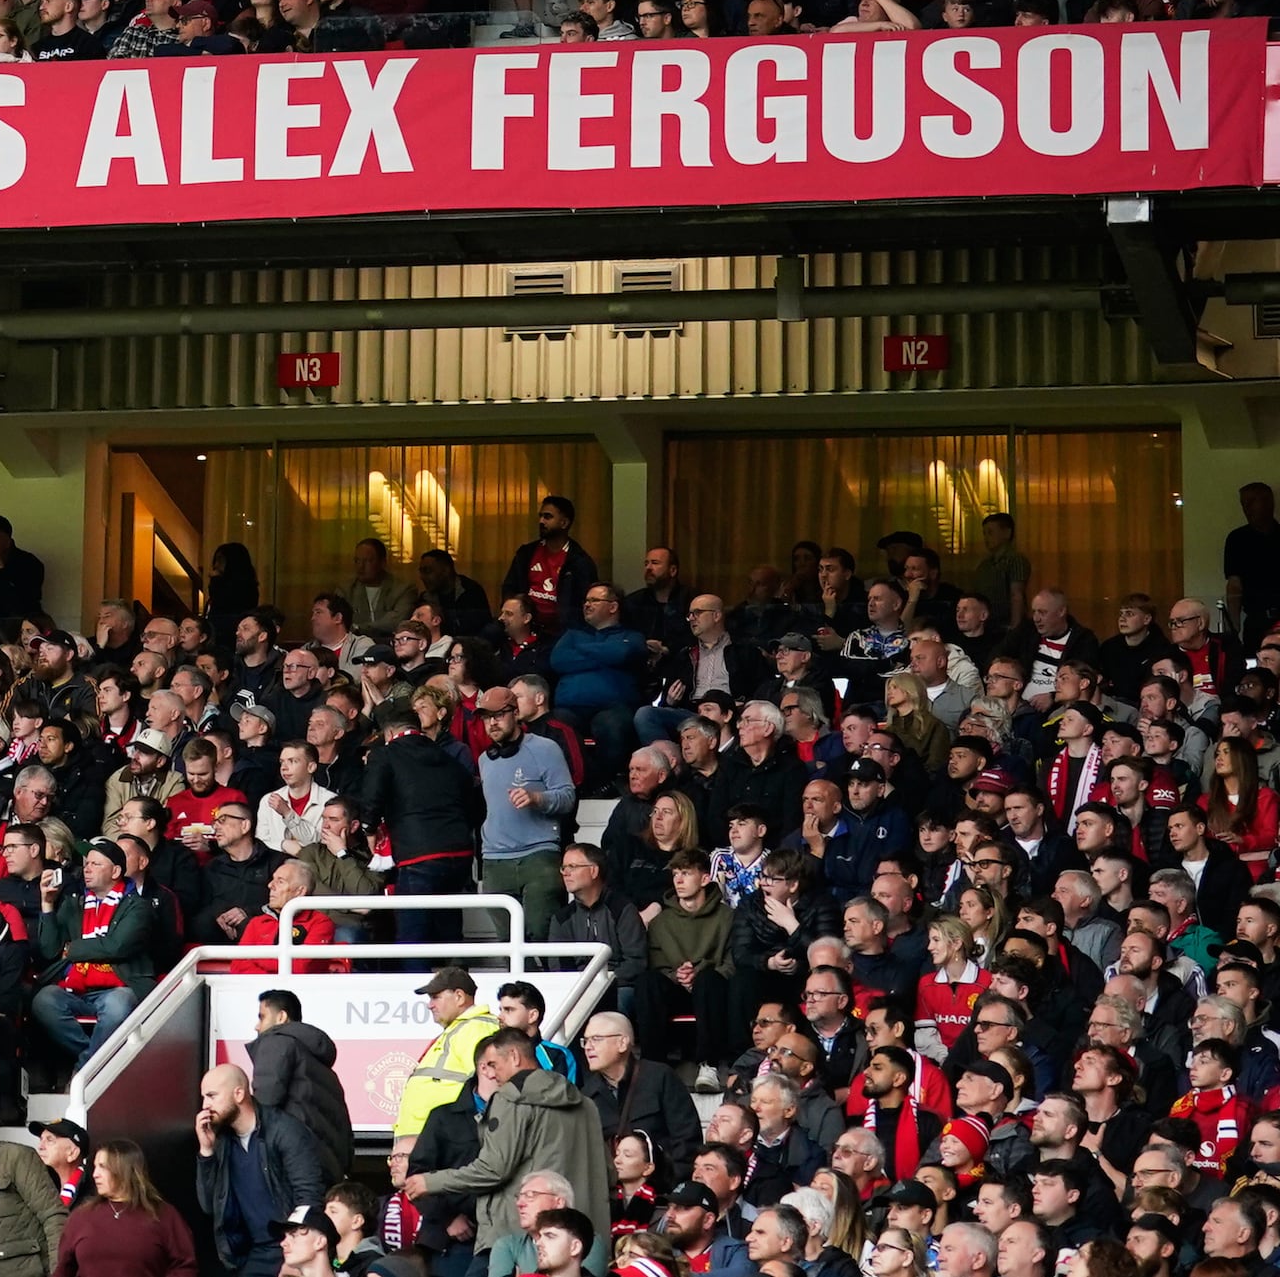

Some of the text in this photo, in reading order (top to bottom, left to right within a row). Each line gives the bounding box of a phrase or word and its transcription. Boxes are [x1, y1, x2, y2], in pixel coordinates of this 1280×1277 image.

[77, 59, 418, 187] ALEX
[472, 31, 1209, 170] FERGUSON
[902, 340, 929, 365] N2
[295, 357, 321, 382] N3
